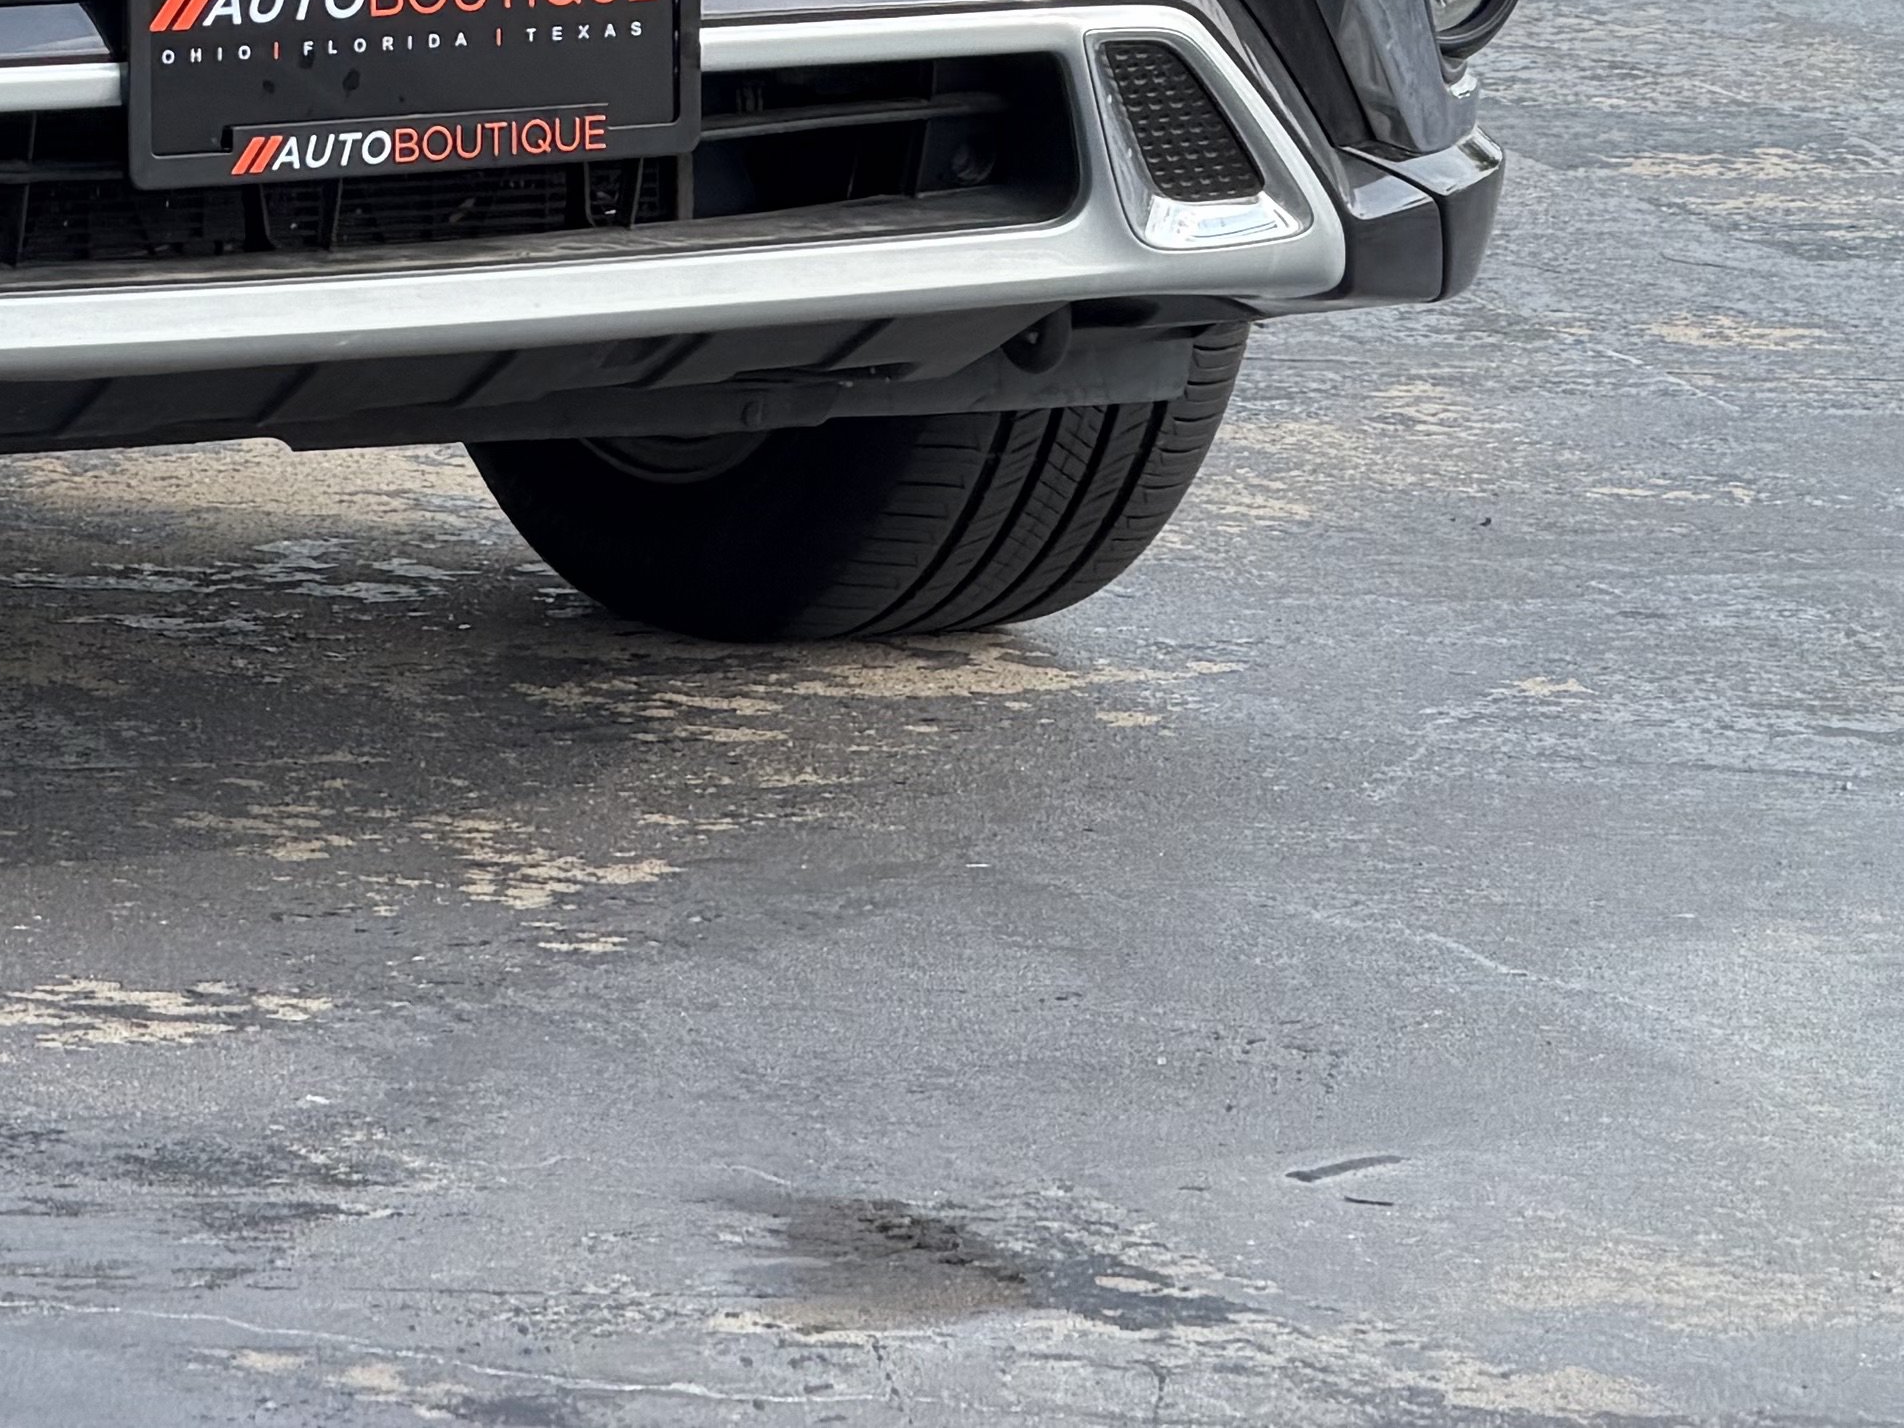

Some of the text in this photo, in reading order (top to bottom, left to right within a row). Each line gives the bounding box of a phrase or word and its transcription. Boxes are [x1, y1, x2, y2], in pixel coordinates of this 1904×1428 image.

[161, 20, 644, 65] OHIO FLORIDA TEXAS
[271, 115, 608, 171] AUTOBOUTIQUE
